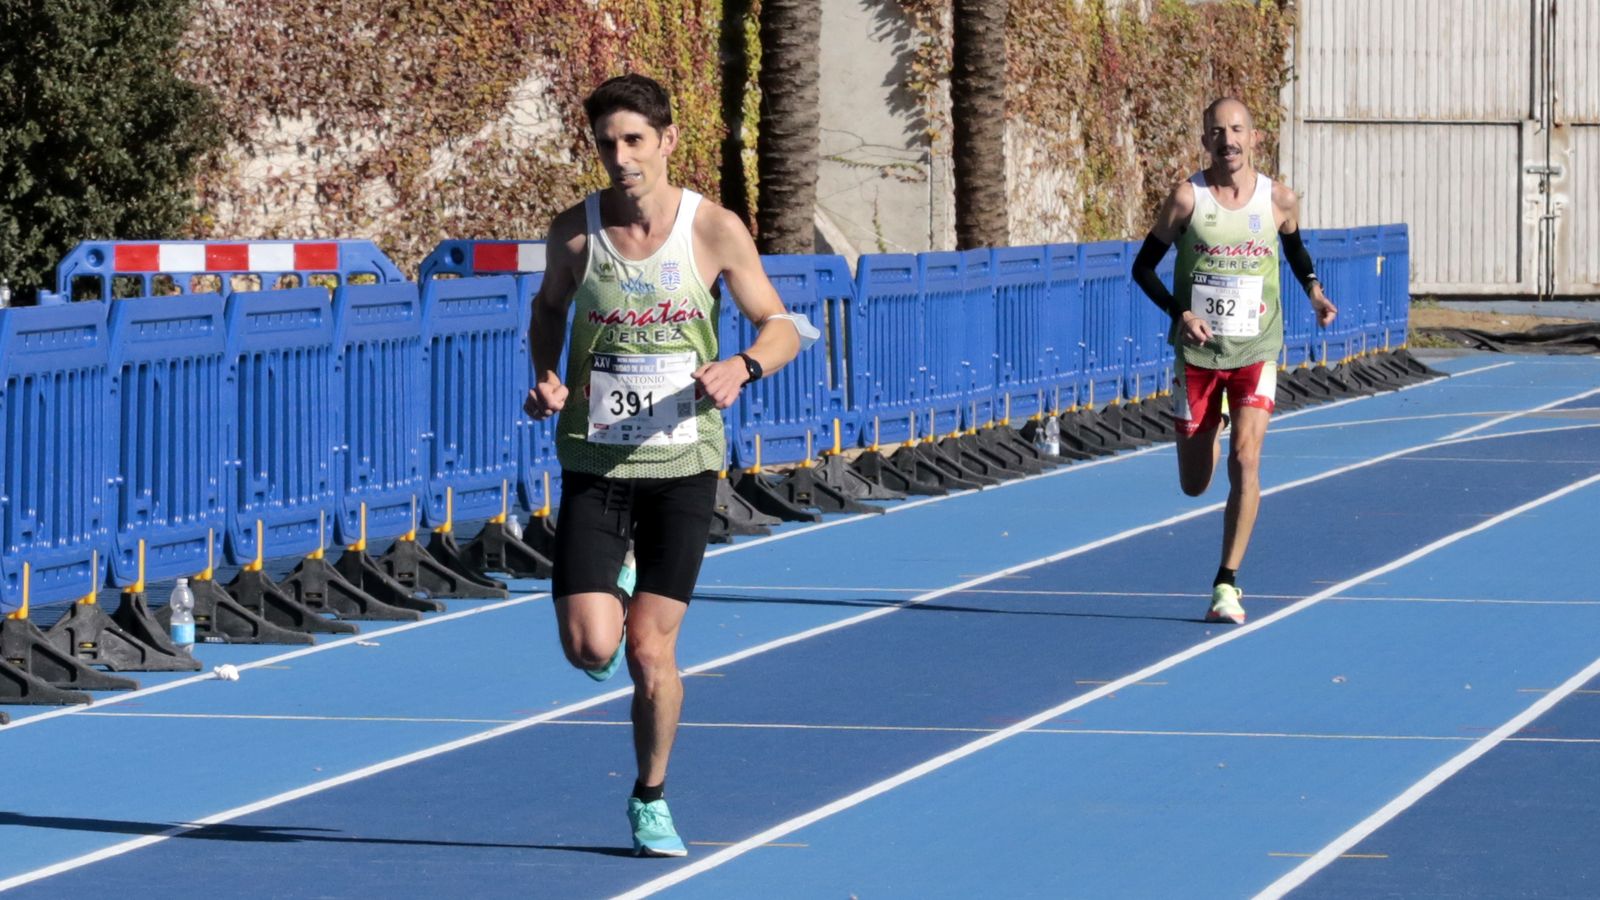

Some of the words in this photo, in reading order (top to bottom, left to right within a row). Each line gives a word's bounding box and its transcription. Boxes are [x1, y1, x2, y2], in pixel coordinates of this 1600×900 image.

[1193, 239, 1273, 257] maratón
[1206, 259, 1260, 270] JEREZ
[587, 298, 705, 327] maratón
[1205, 297, 1236, 317] 362
[604, 328, 683, 344] JEREZ
[593, 356, 611, 369] XXV
[619, 375, 665, 386] ANTONIO
[610, 390, 654, 417] 391
